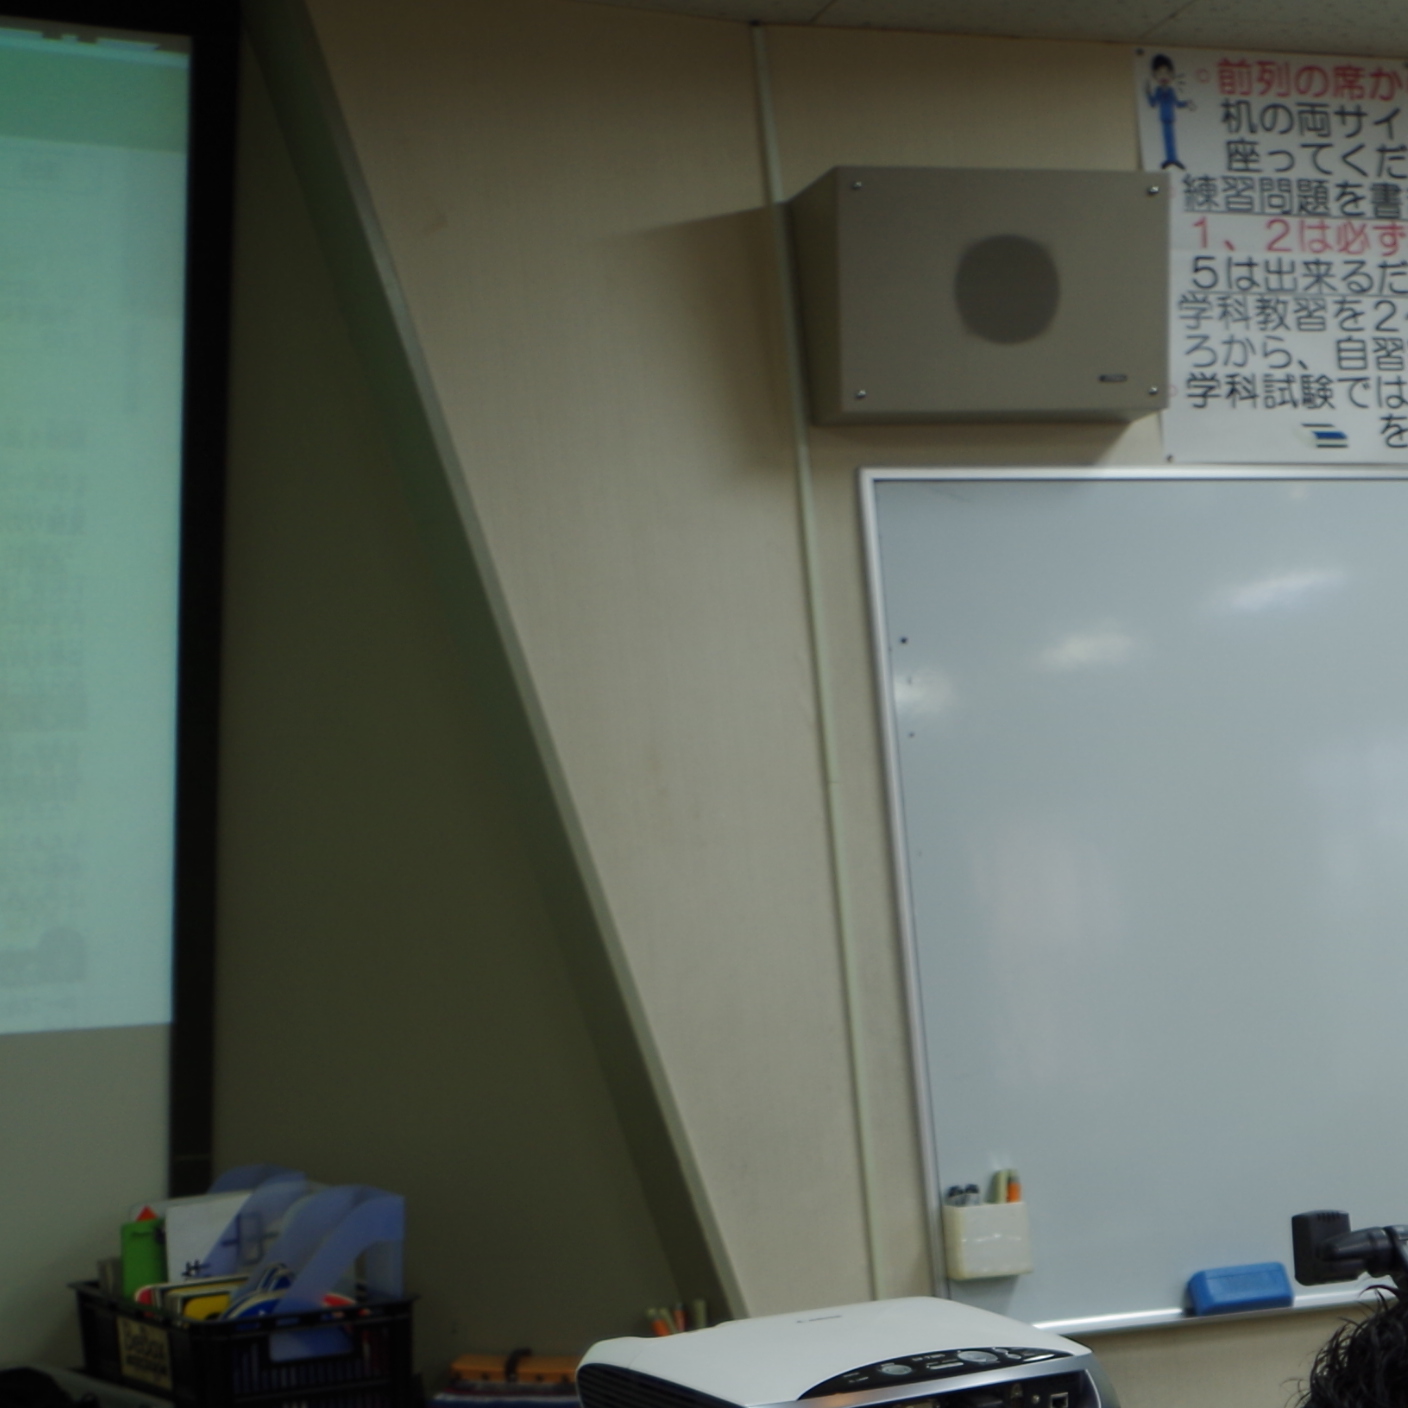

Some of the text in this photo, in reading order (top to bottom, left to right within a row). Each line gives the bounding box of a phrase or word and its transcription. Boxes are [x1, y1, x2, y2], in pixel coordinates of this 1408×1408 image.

[1186, 374, 1408, 411] 学科試験では
